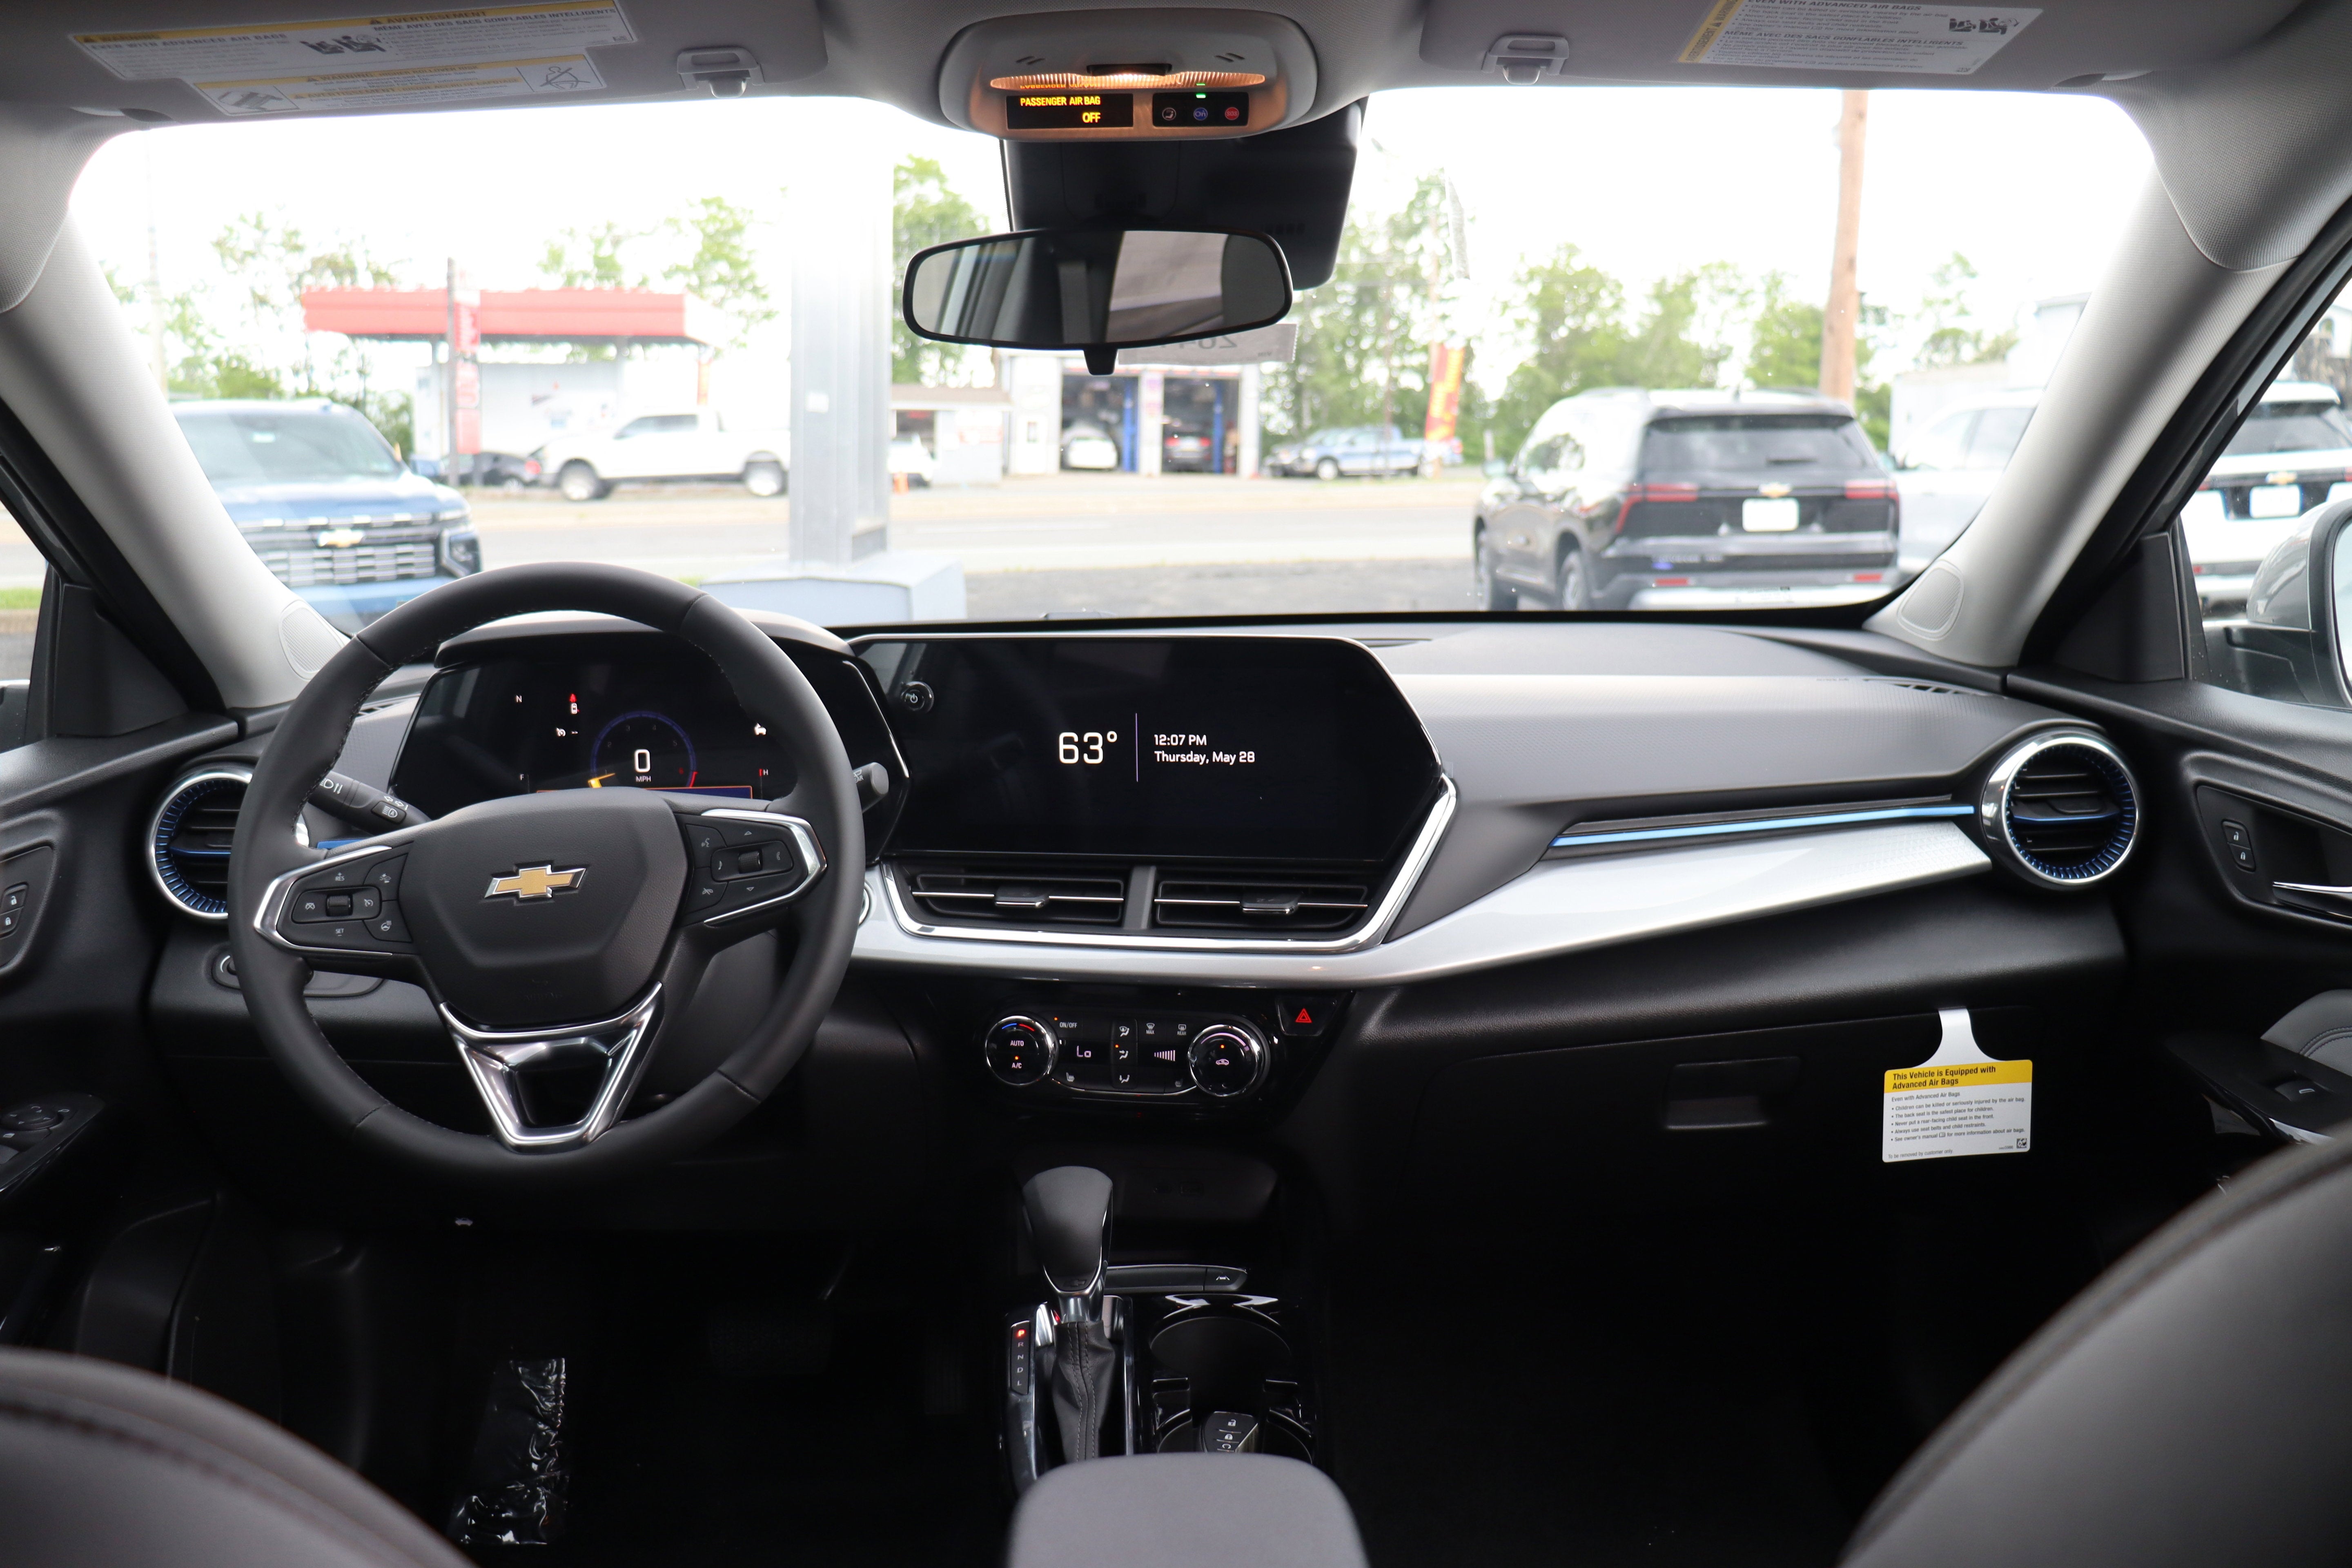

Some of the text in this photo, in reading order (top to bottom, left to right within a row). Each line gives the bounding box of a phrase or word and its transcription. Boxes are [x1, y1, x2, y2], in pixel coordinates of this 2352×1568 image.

[482, 14, 548, 23] GONFLABLES
[547, 9, 617, 18] INTELLIGENTS
[1020, 96, 1100, 107] PASSENGER AIR BAG
[1082, 112, 1101, 123] OFF
[1154, 734, 1207, 746] 12:07 PM
[1059, 731, 1118, 764] 63°
[635, 749, 651, 773] 0
[1154, 751, 1255, 765] Thursday, May 28
[1909, 1069, 1935, 1079] Vehicle
[1937, 1069, 1943, 1077] is
[1944, 1066, 1978, 1077] Equipped
[1893, 1077, 1959, 1089] Advanced Air Bags
